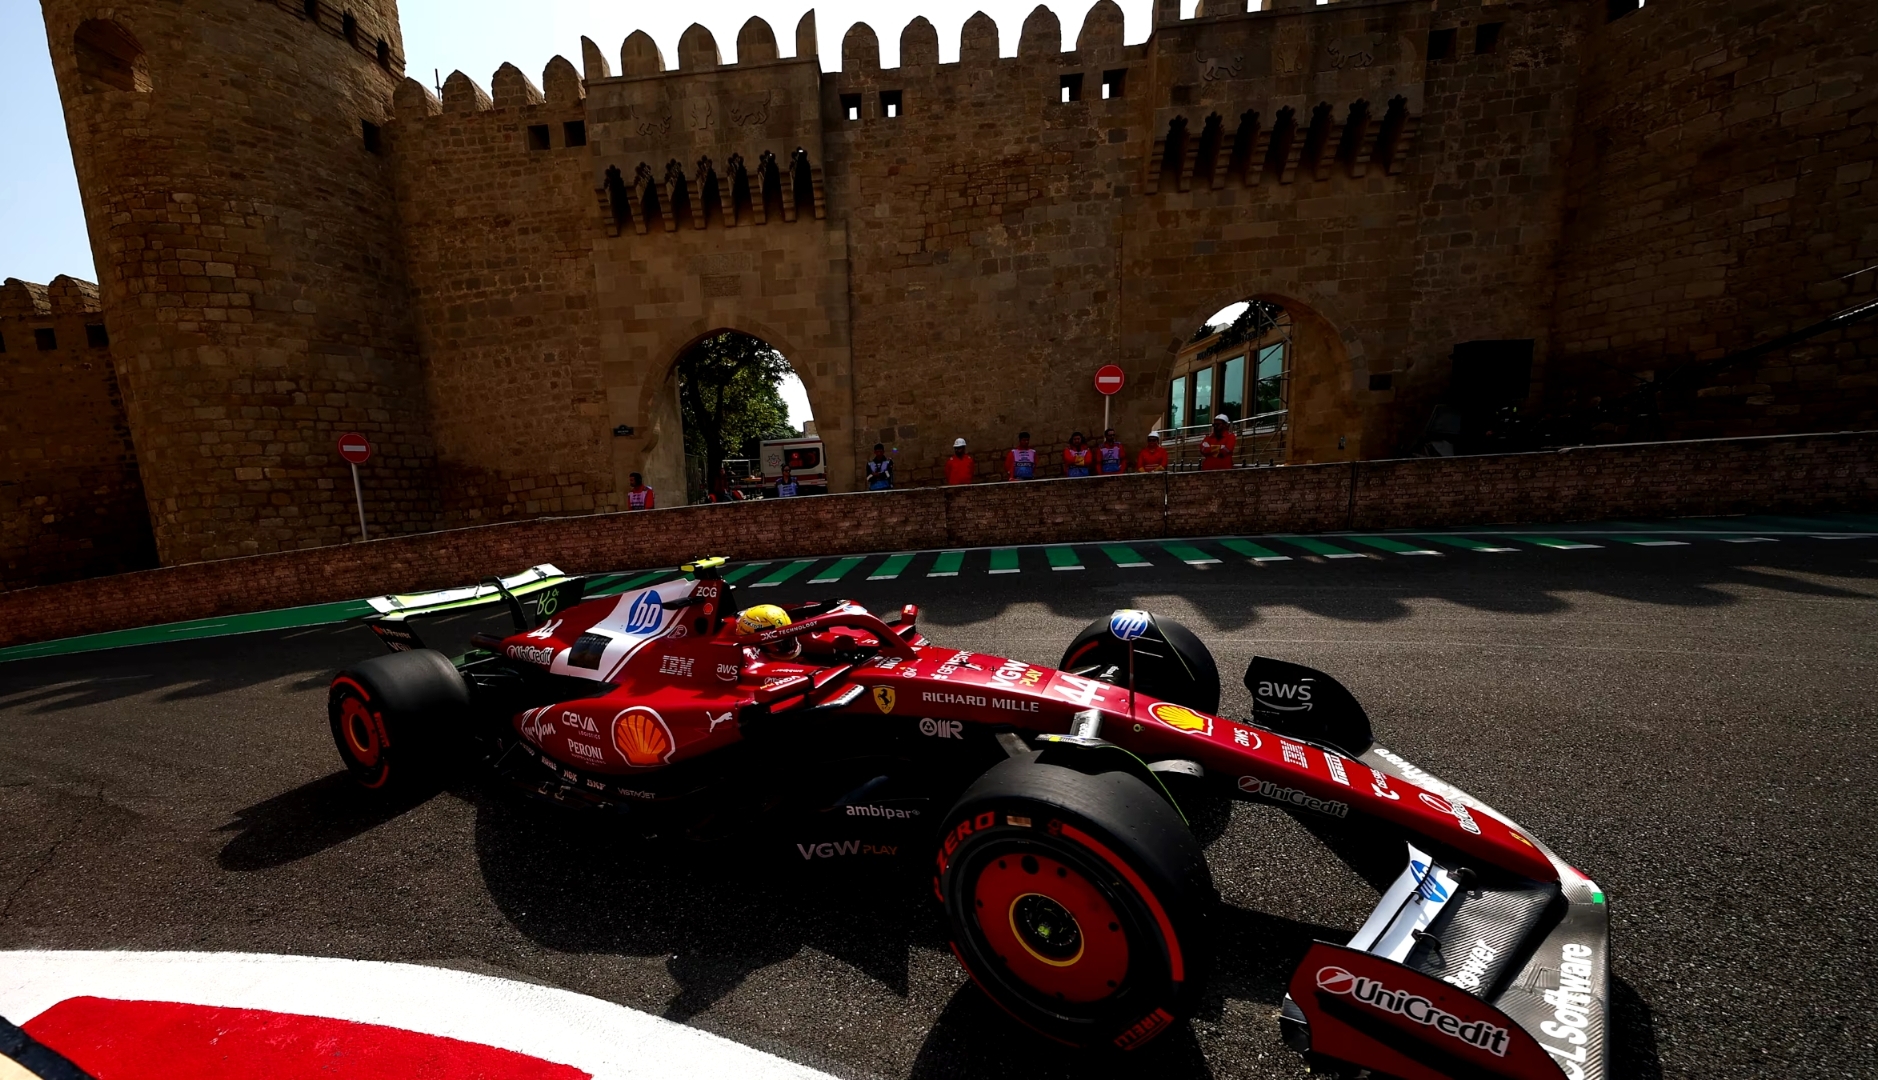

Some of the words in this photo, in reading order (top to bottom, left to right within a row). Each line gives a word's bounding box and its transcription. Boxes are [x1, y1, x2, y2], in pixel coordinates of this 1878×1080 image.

[695, 586, 718, 598] ZCG
[628, 590, 662, 634] hp
[779, 620, 818, 635] TECHNOLOGY
[659, 654, 695, 678] IBM
[716, 663, 738, 676] aws
[986, 659, 1030, 688] VGW
[922, 691, 987, 707] RICHARD
[991, 697, 1040, 713] MILLE
[1053, 674, 1111, 706] 44
[1257, 680, 1312, 701] aws
[567, 738, 604, 760] PERONI
[1323, 752, 1350, 786] PIRELLI
[1259, 781, 1349, 818] UniCredit
[846, 804, 912, 820] ambipar
[796, 840, 861, 861] VGW
[863, 844, 899, 856] PLAY
[1539, 943, 1593, 1046] Software
[1354, 976, 1509, 1056] UniCredit
[1113, 1006, 1175, 1051] PIRELLI
